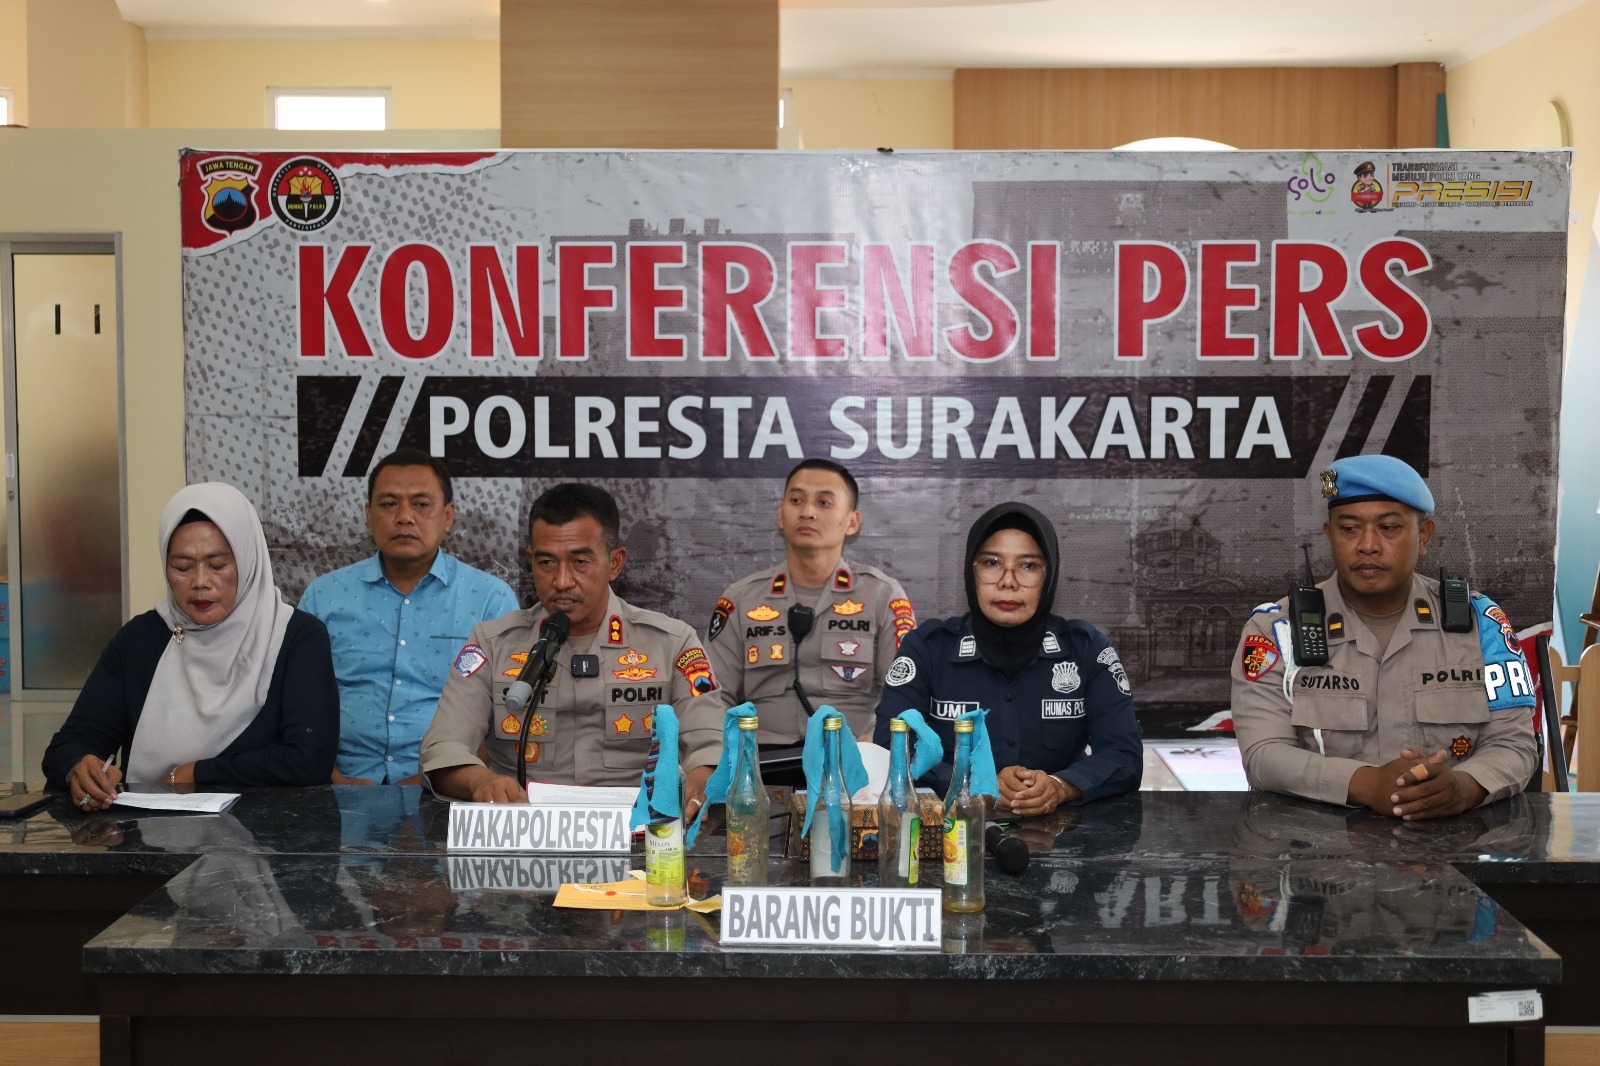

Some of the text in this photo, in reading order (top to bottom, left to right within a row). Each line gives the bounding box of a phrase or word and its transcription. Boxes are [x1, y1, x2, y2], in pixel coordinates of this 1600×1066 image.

[205, 161, 254, 172] JAWA TENGAH
[1391, 162, 1459, 172] TRANSFORMASI
[1391, 181, 1533, 202] PRESISI
[297, 238, 1433, 361] KONFERENSI PERS
[429, 395, 1292, 460] POLRESTA SURAKARTA
[746, 625, 786, 639] ARIF.S
[828, 619, 870, 632] POLRI
[1300, 674, 1360, 691] SUTARSO
[1422, 668, 1482, 685] POLRI
[611, 686, 663, 702] POLRI
[1045, 701, 1072, 716] HUMAS
[452, 809, 626, 849] WAKAPOLRESTA
[728, 894, 935, 942] BARANG BUKTI
